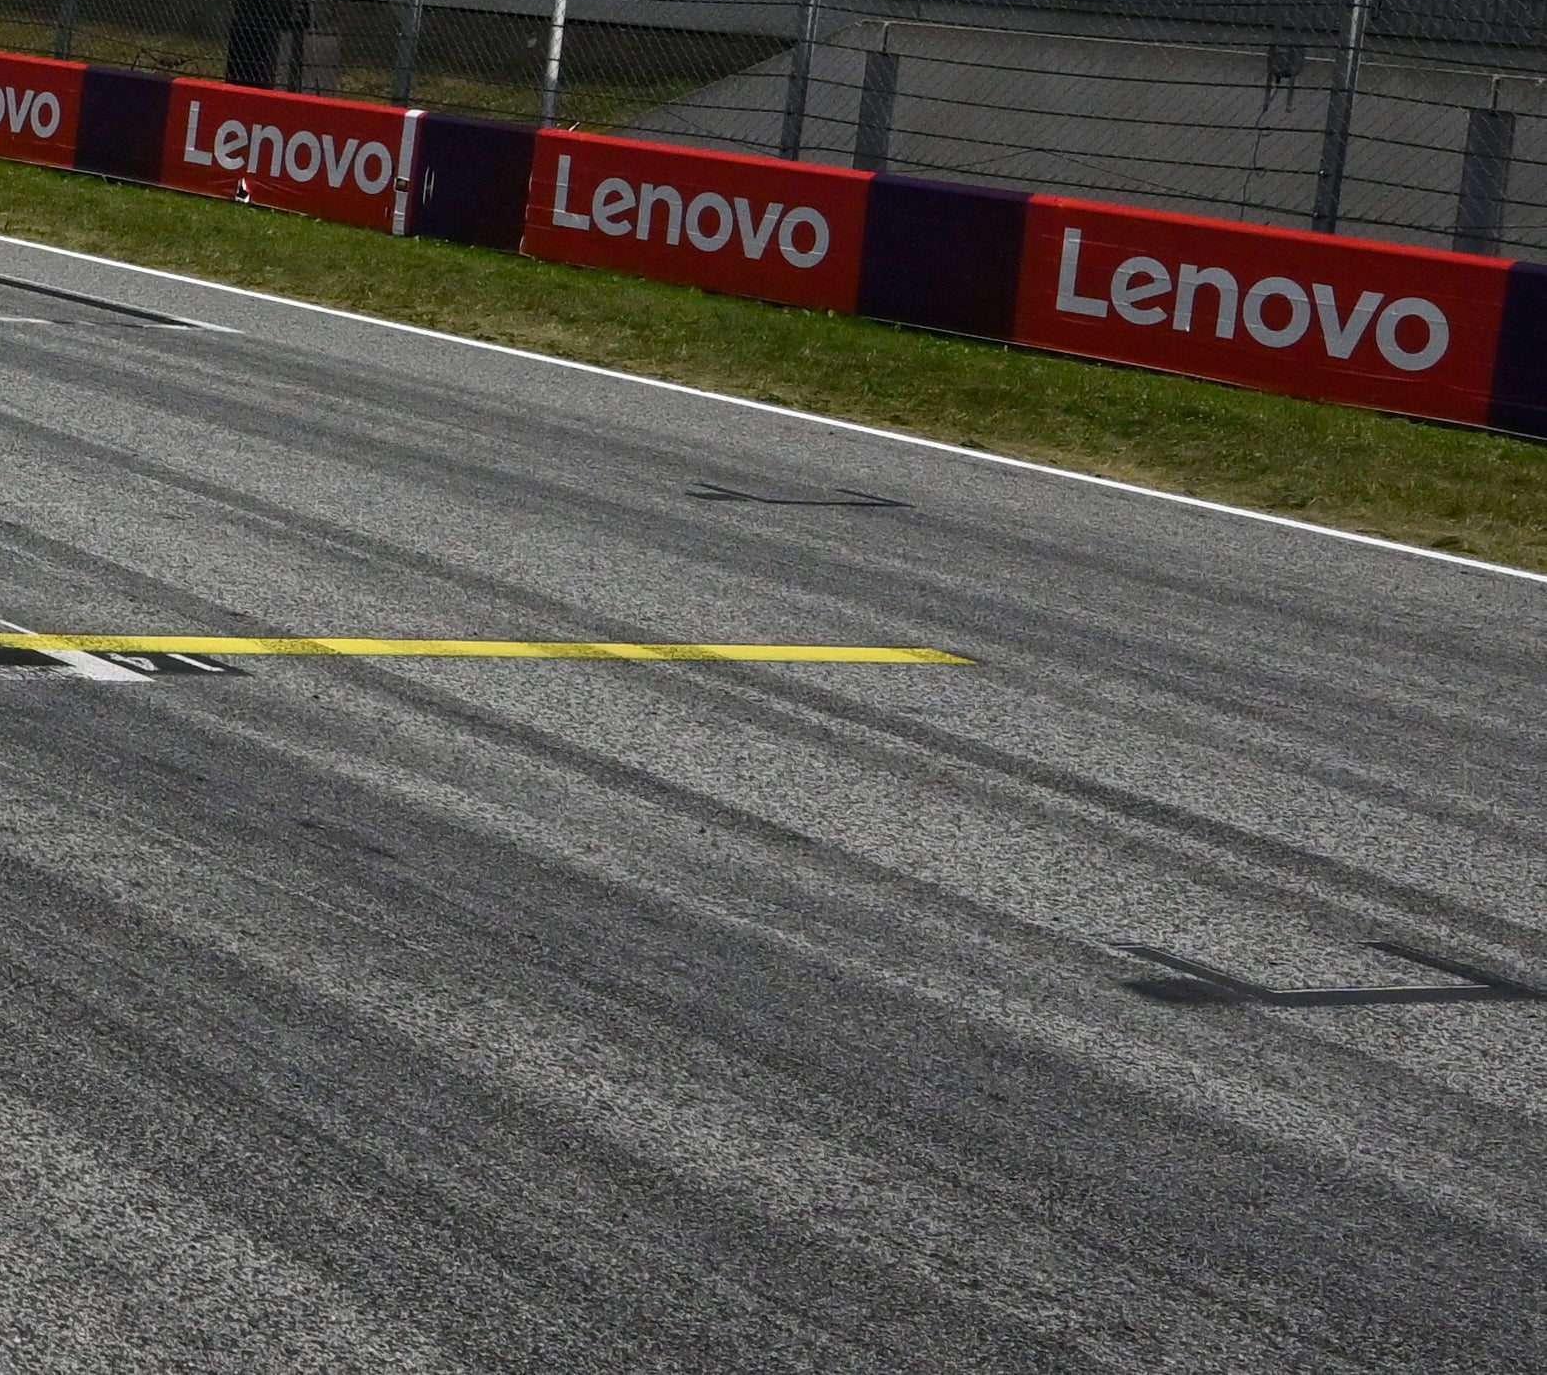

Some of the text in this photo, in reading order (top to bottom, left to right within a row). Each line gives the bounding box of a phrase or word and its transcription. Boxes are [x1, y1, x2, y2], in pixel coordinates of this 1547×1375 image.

[184, 101, 392, 194] Lenovo
[551, 155, 830, 269] Lenovo
[1055, 228, 1450, 372] Lenovo
